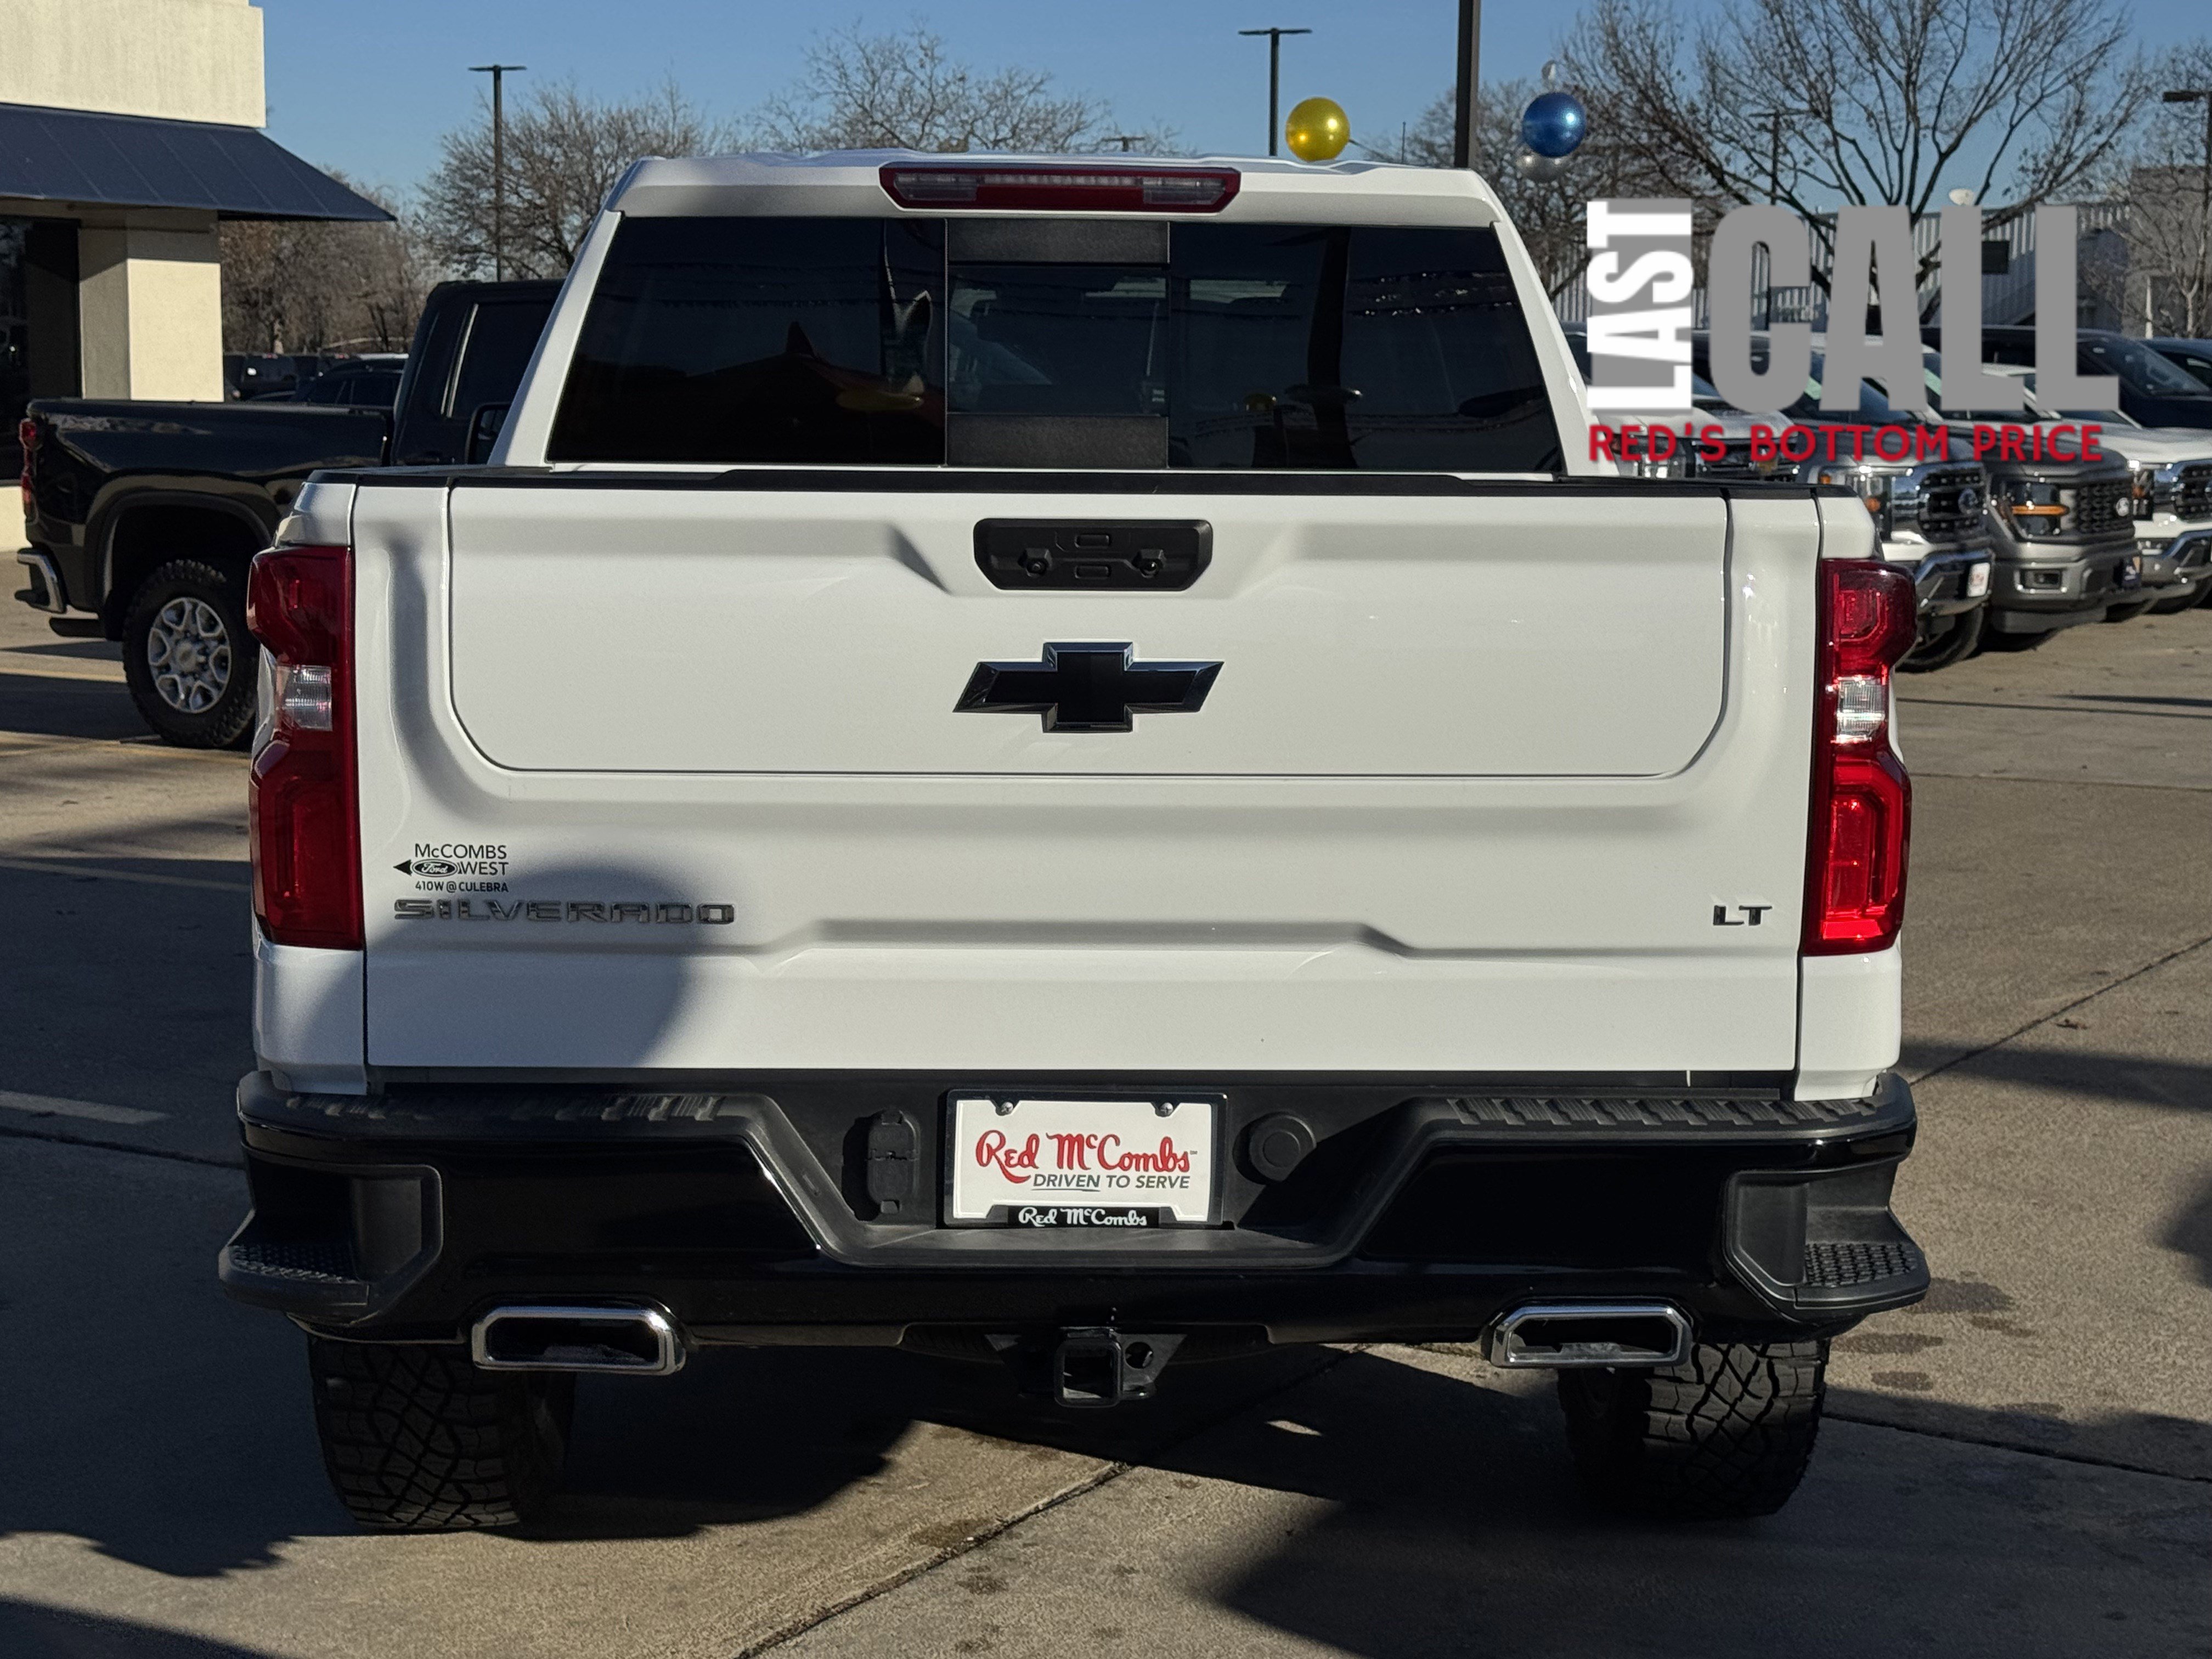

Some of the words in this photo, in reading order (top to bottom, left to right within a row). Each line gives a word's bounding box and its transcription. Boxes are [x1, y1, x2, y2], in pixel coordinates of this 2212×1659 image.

[415, 843, 507, 859] McCOMBS
[421, 862, 448, 873] Ford
[462, 861, 509, 876] WEST
[459, 882, 509, 893] CULEBRA
[394, 899, 735, 925] SILVERADO
[1713, 905, 1773, 926] LT
[975, 1130, 1040, 1183] Red
[1046, 1132, 1190, 1173] McCombs
[1033, 1174, 1101, 1188] DRIVEN
[1106, 1175, 1130, 1188] TO
[1135, 1175, 1190, 1189] SERVE
[1018, 1207, 1058, 1227] Red
[1059, 1207, 1147, 1226] McCombs
